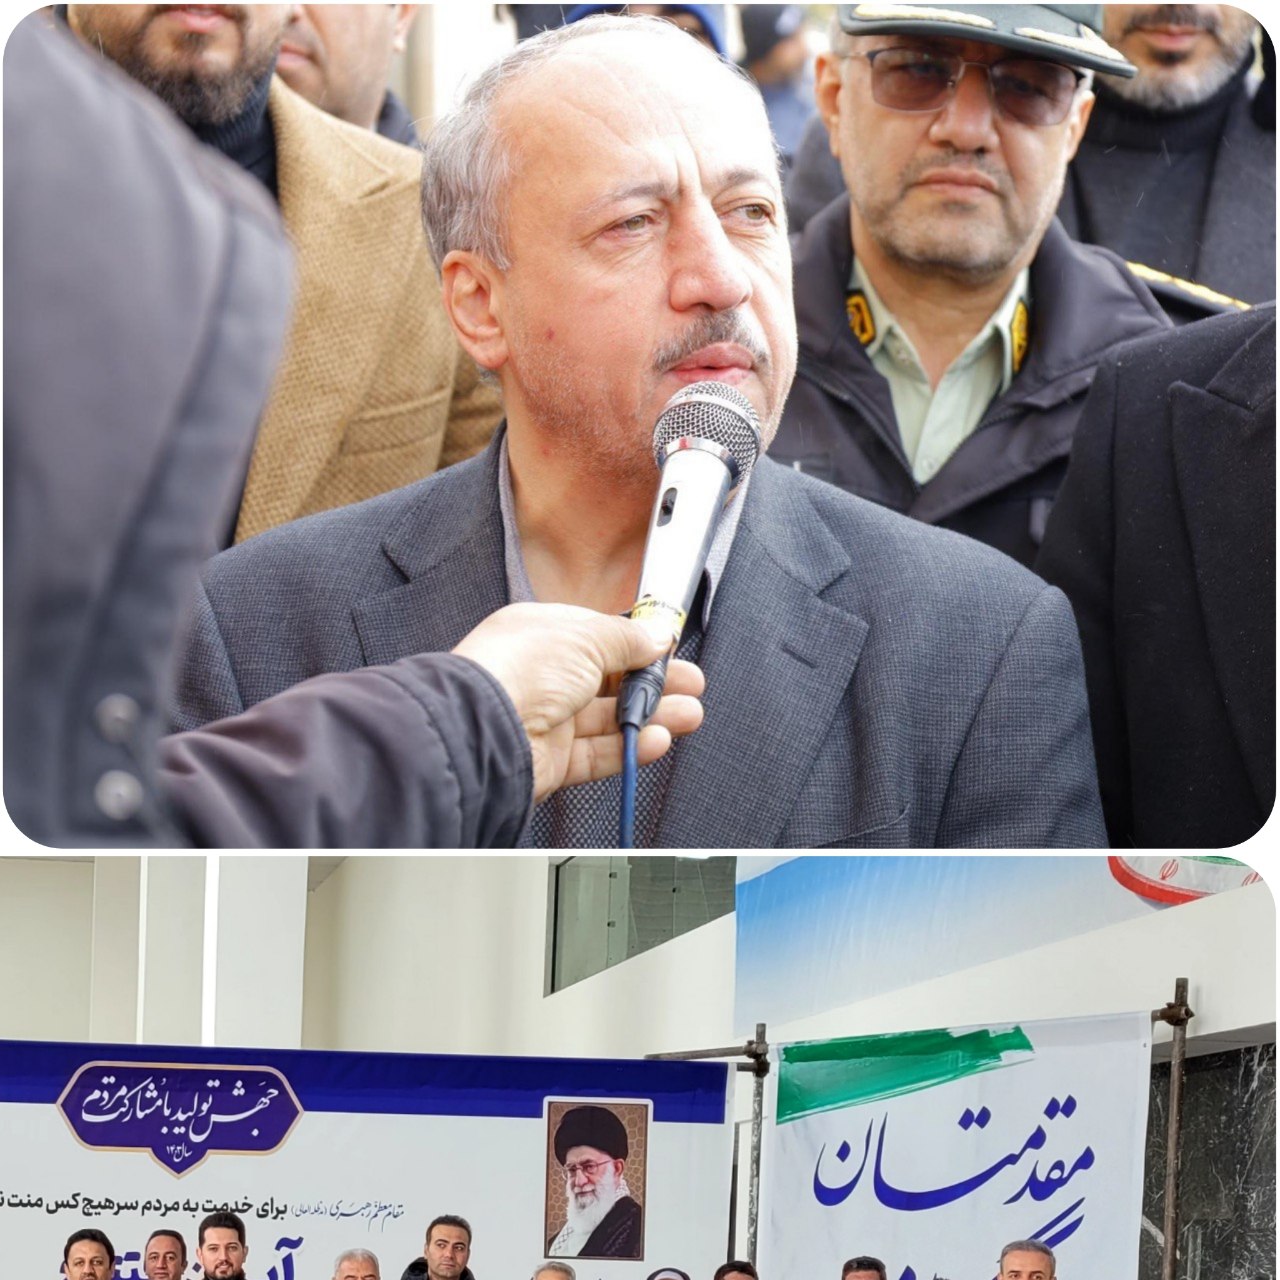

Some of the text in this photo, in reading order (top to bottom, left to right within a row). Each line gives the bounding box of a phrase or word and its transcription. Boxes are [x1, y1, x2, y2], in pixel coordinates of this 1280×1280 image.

[170, 1079, 220, 1135] تولید
[6, 1193, 44, 1209] منت
[45, 1192, 81, 1215] کس
[141, 1198, 180, 1217] مردم
[182, 1198, 199, 1218] به
[201, 1195, 254, 1214] خدمت
[256, 1197, 288, 1219] برای
